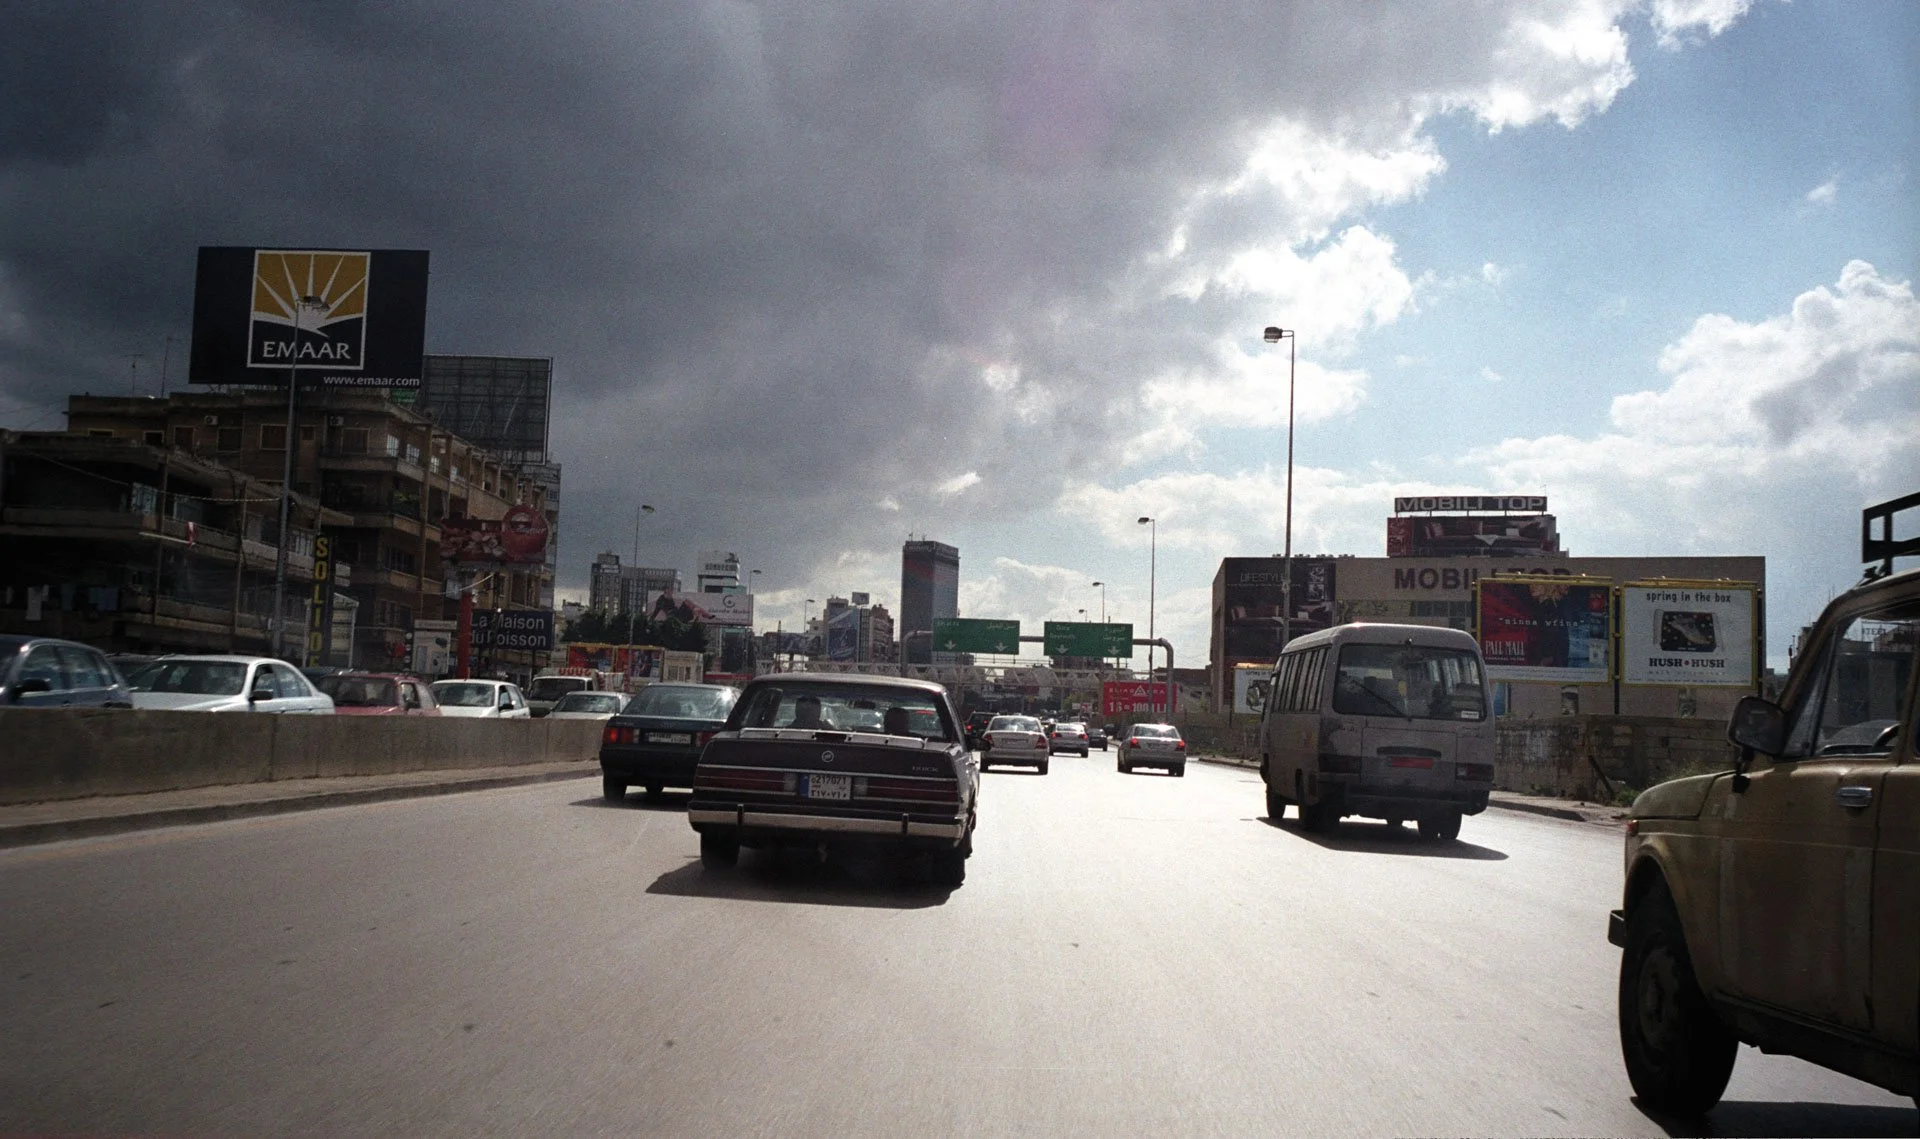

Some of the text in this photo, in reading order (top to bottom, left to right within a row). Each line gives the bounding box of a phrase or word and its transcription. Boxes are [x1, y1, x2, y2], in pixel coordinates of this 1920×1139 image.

[263, 341, 351, 359] EMAAR
[323, 376, 420, 386] www.emaar.com
[1397, 496, 1544, 511] MOBILI TOP
[1646, 591, 1732, 603] spring in the box
[1485, 640, 1525, 657] PALL MALL
[1649, 658, 1726, 669] HUSH HUSH
